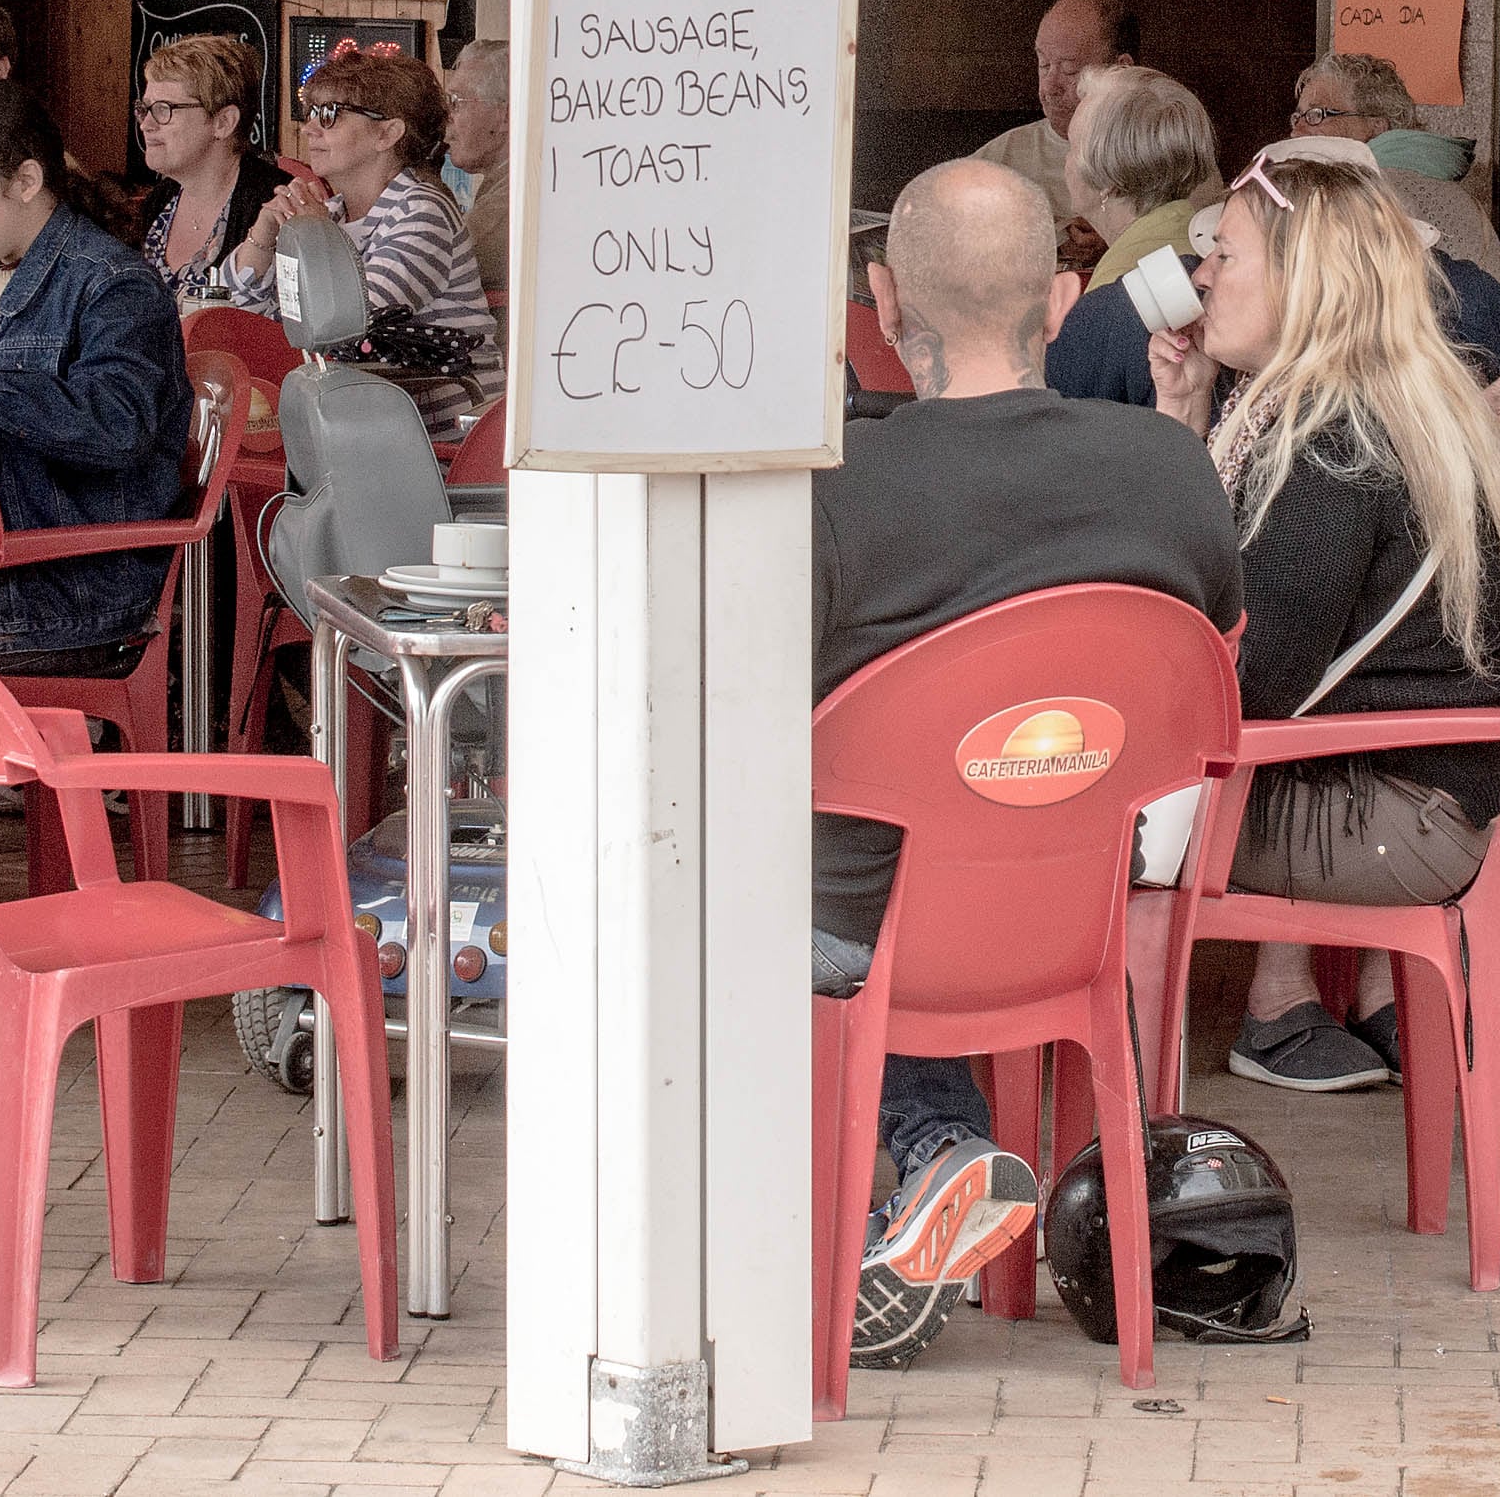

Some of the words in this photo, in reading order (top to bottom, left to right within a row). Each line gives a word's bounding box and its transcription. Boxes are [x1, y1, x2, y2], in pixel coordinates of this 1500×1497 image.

[581, 10, 758, 61] SAUSAGE,
[1340, 6, 1384, 26] CADA
[1400, 6, 1426, 26] DIA
[551, 77, 664, 124] BAKED
[675, 68, 811, 117] BEANS,
[593, 226, 714, 276] ONLY
[551, 299, 755, 400] €2-50
[966, 758, 1051, 778] CAFETERIA
[1055, 752, 1109, 773] MANILA
